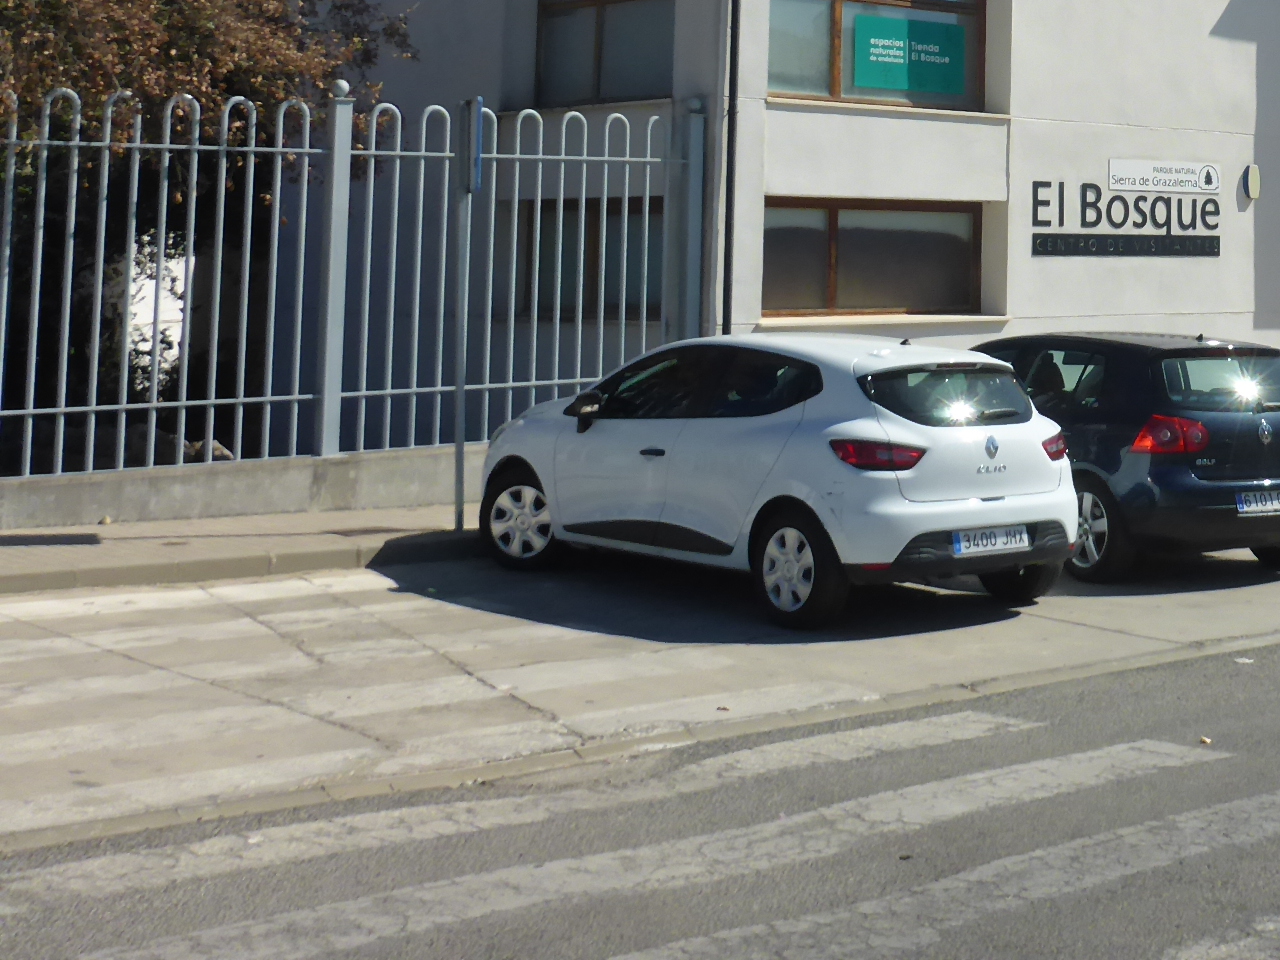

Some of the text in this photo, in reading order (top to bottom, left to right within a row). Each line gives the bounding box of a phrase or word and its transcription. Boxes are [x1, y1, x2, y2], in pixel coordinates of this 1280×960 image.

[870, 37, 904, 47] espacios
[911, 41, 940, 52] Tienda
[870, 47, 904, 56] naturales
[911, 52, 950, 64] El Bosque
[1152, 166, 1197, 175] PARQUE NATURAL
[1111, 174, 1198, 188] Sierra de Grazalema
[1032, 180, 1221, 235] El Bosque
[1036, 238, 1098, 252] CENTRO
[1107, 238, 1124, 251] DE
[1195, 458, 1216, 466] GOLF
[976, 464, 1007, 474] CLIO
[1243, 493, 1274, 508] 6101
[963, 529, 1025, 549] 3400 JHX
